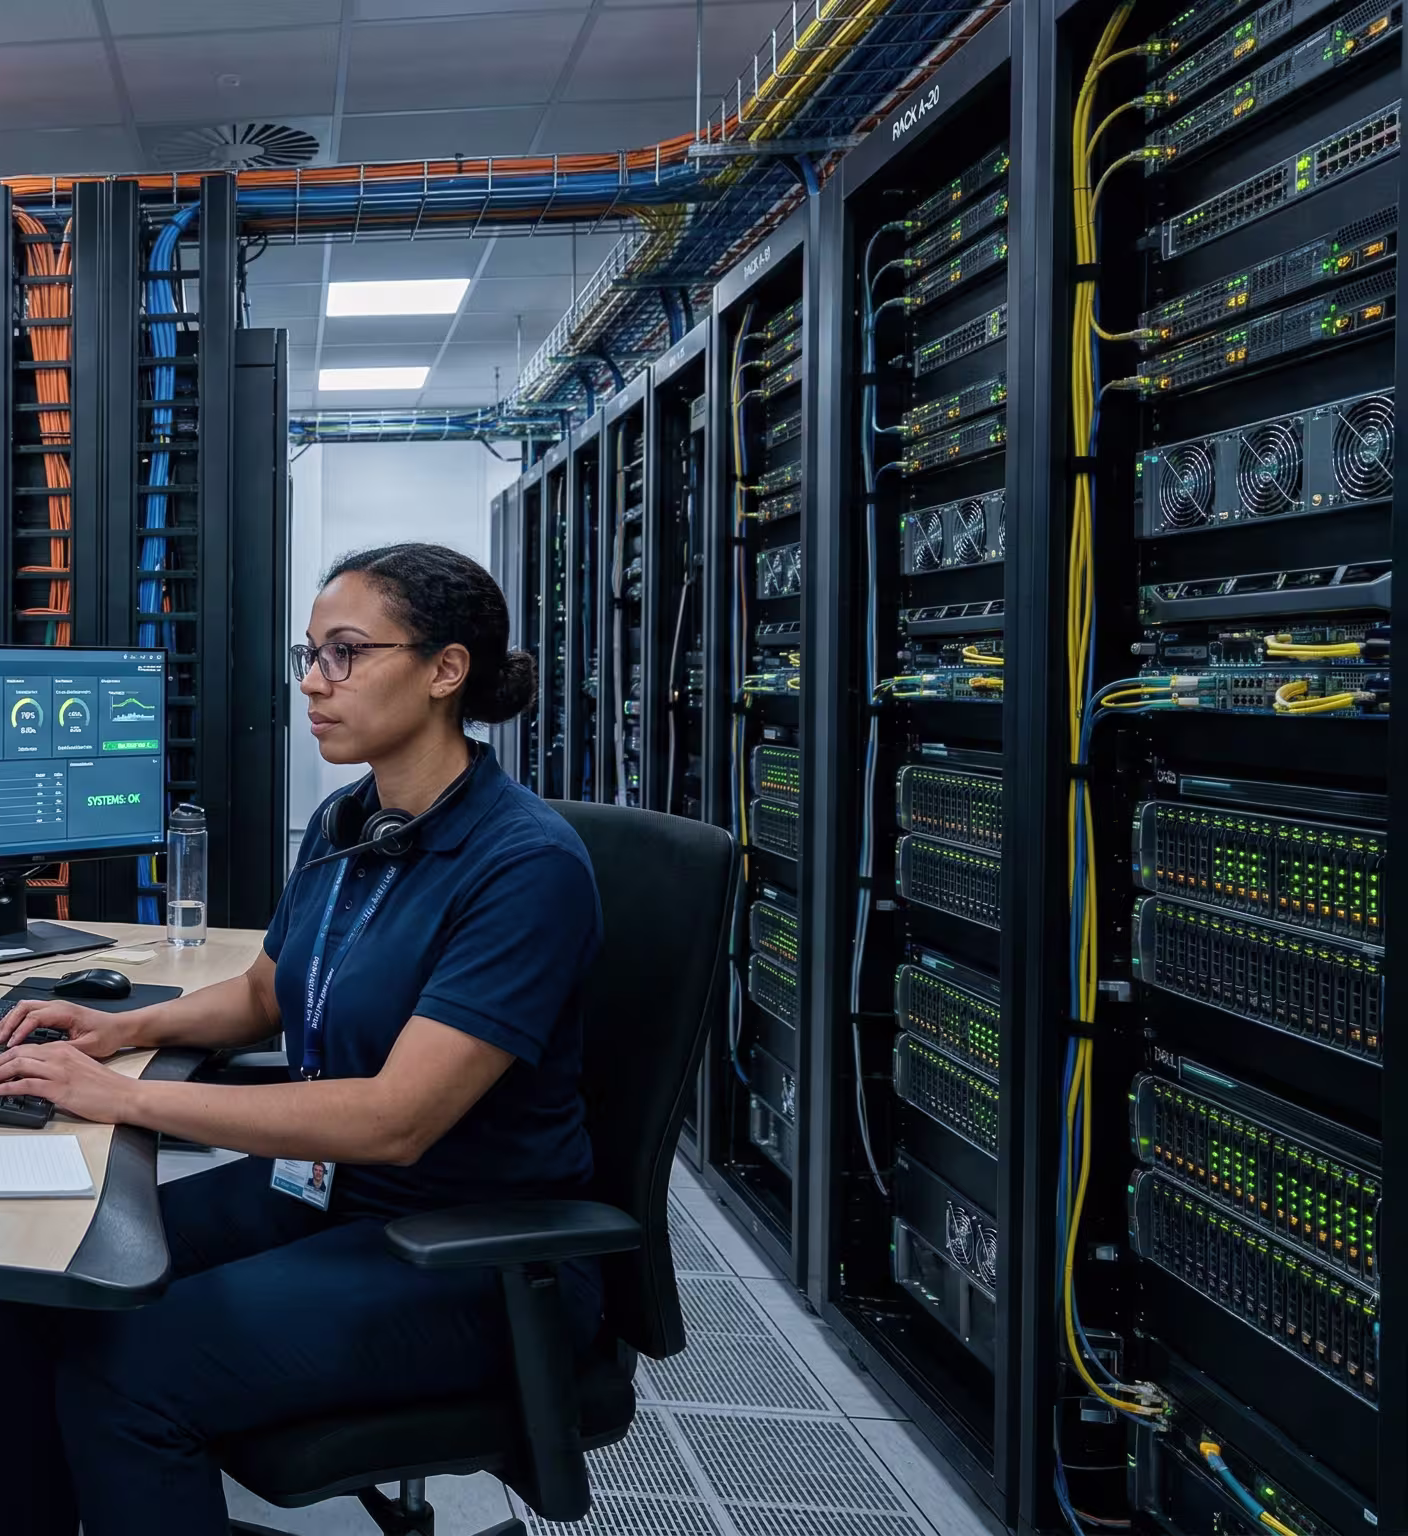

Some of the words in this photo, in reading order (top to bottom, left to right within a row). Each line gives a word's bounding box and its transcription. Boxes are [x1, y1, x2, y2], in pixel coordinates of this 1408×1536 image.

[892, 104, 918, 141] RACK
[918, 84, 940, 120] A-20
[87, 794, 127, 806] SYSTEMS:
[127, 793, 141, 804] OK
